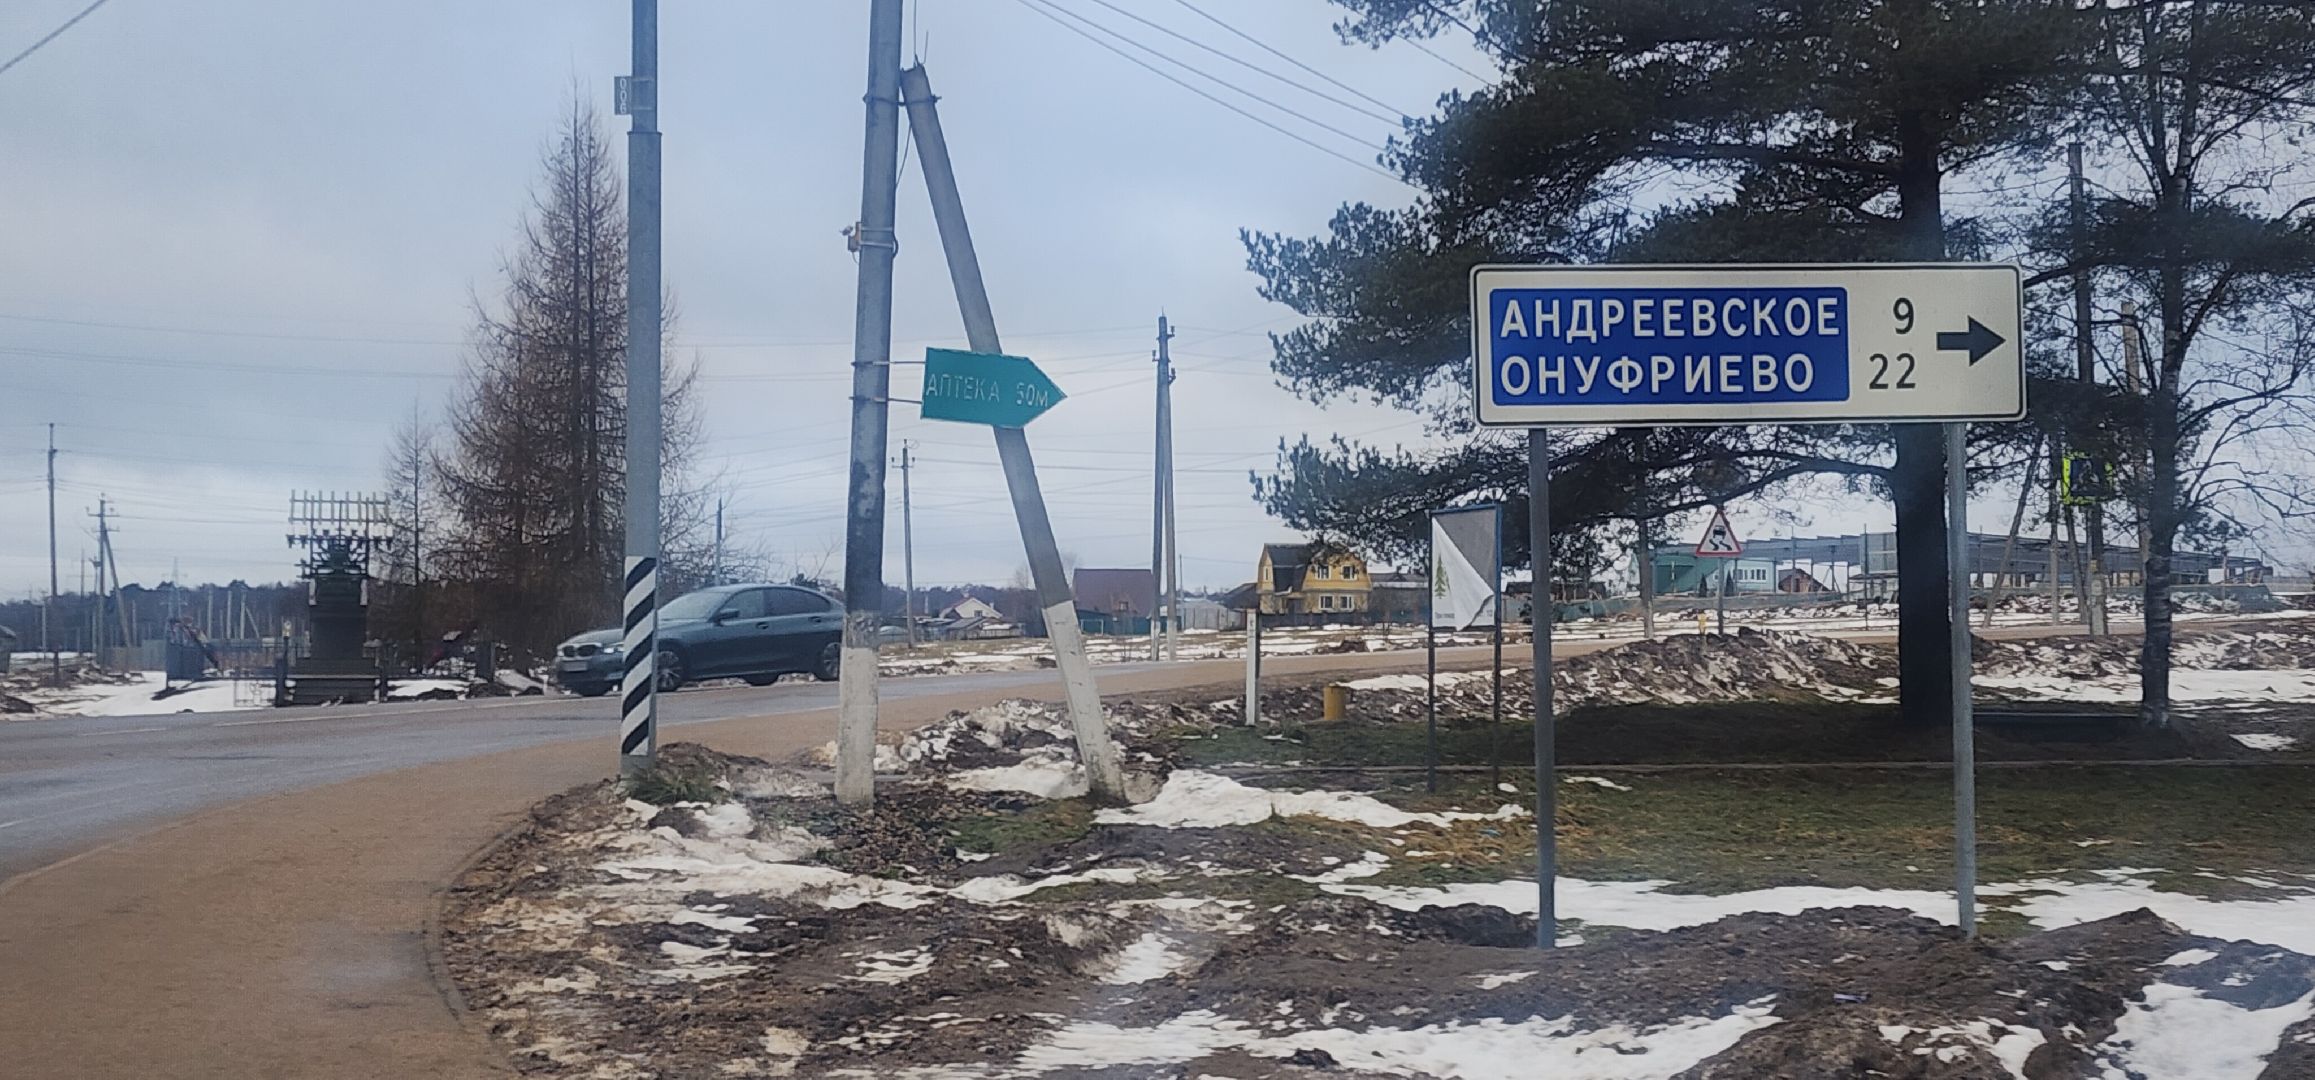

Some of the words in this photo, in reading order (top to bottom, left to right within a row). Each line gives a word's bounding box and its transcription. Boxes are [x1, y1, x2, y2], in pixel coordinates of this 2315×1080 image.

[1499, 296, 1838, 344] АНДРЕЕВСКОЕ
[1892, 297, 1914, 336] 9
[925, 373, 1001, 402] АПТЕКА
[1500, 353, 1814, 397] ОНУФРИЕВО
[1868, 354, 1916, 391] 22
